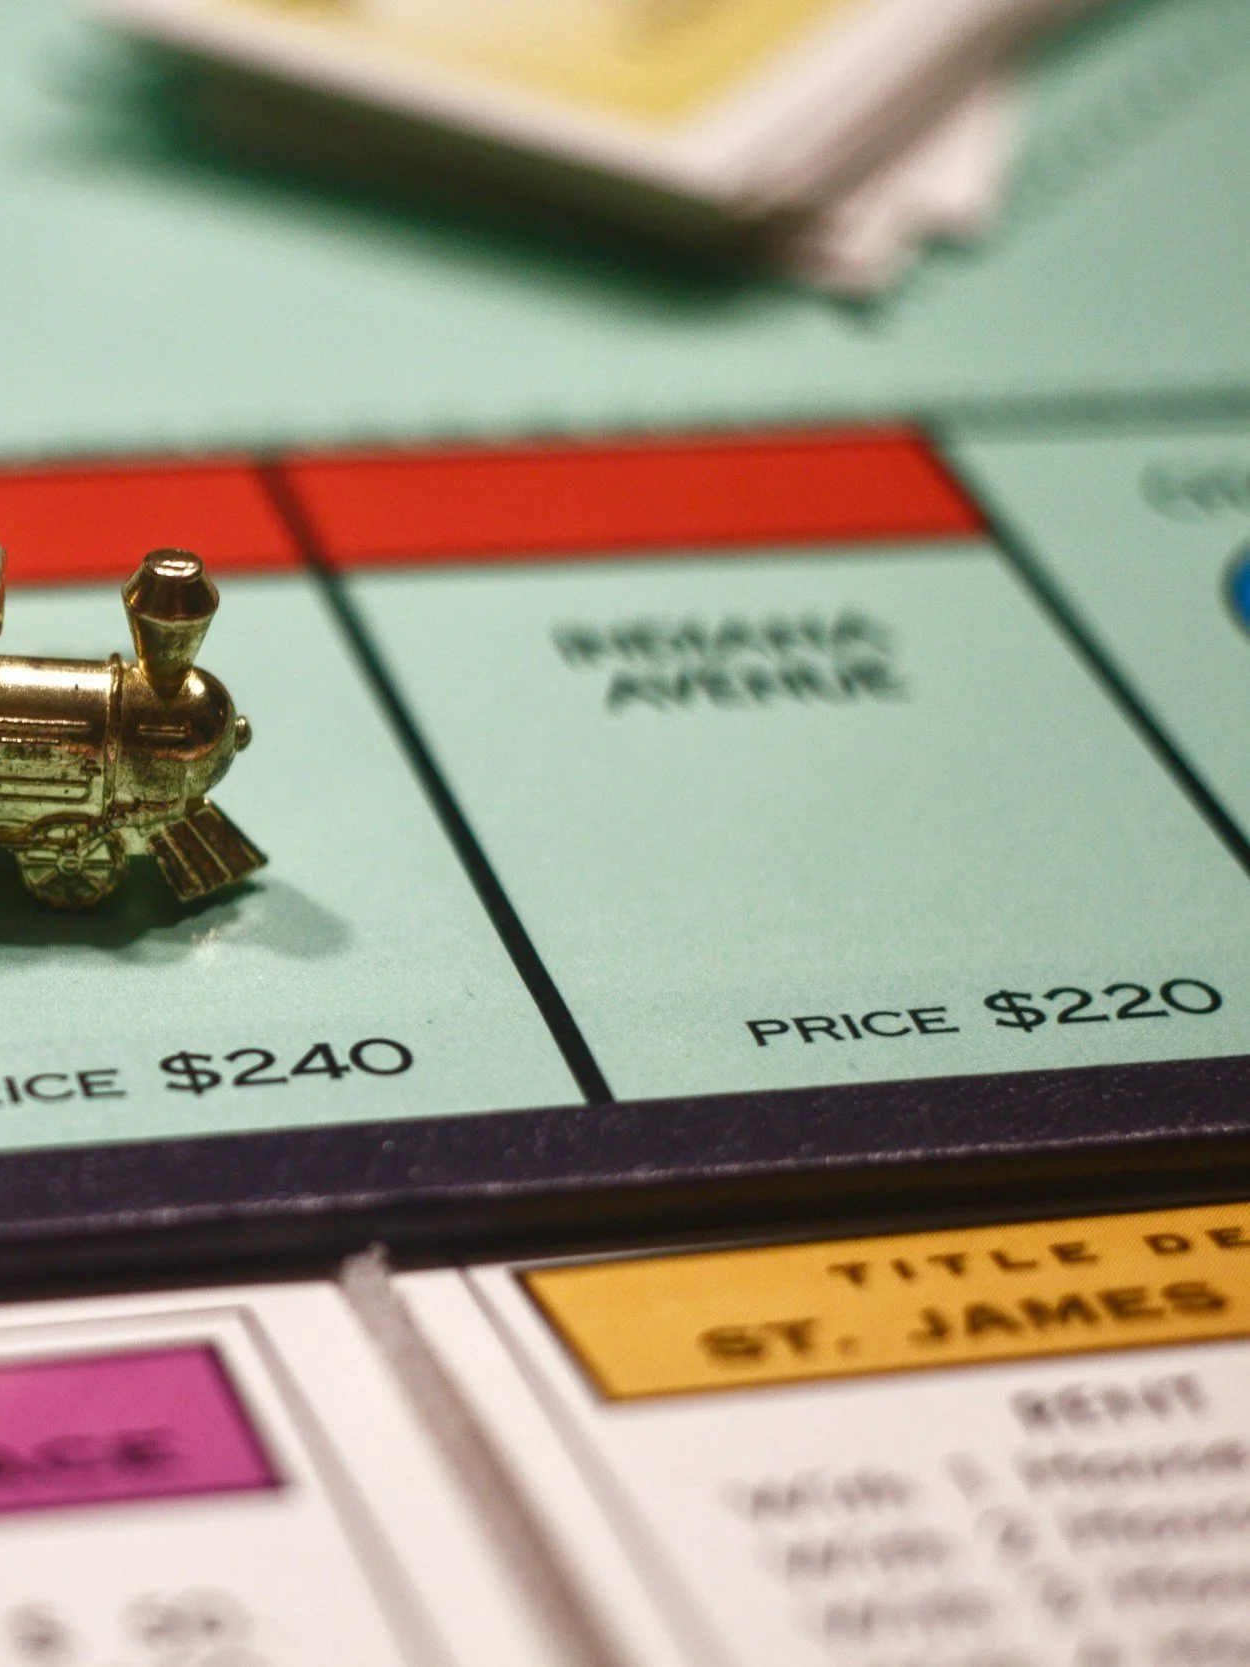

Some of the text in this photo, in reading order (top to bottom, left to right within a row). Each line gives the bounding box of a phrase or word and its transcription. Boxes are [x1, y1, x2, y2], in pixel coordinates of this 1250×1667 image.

[552, 608, 892, 668] INDIANA
[605, 658, 910, 714] AVENUE
[745, 977, 1224, 1048] PRICE $220
[158, 1037, 414, 1097] $240
[826, 1239, 1100, 1287] TITLE
[695, 1280, 1229, 1368] ST. JAMES
